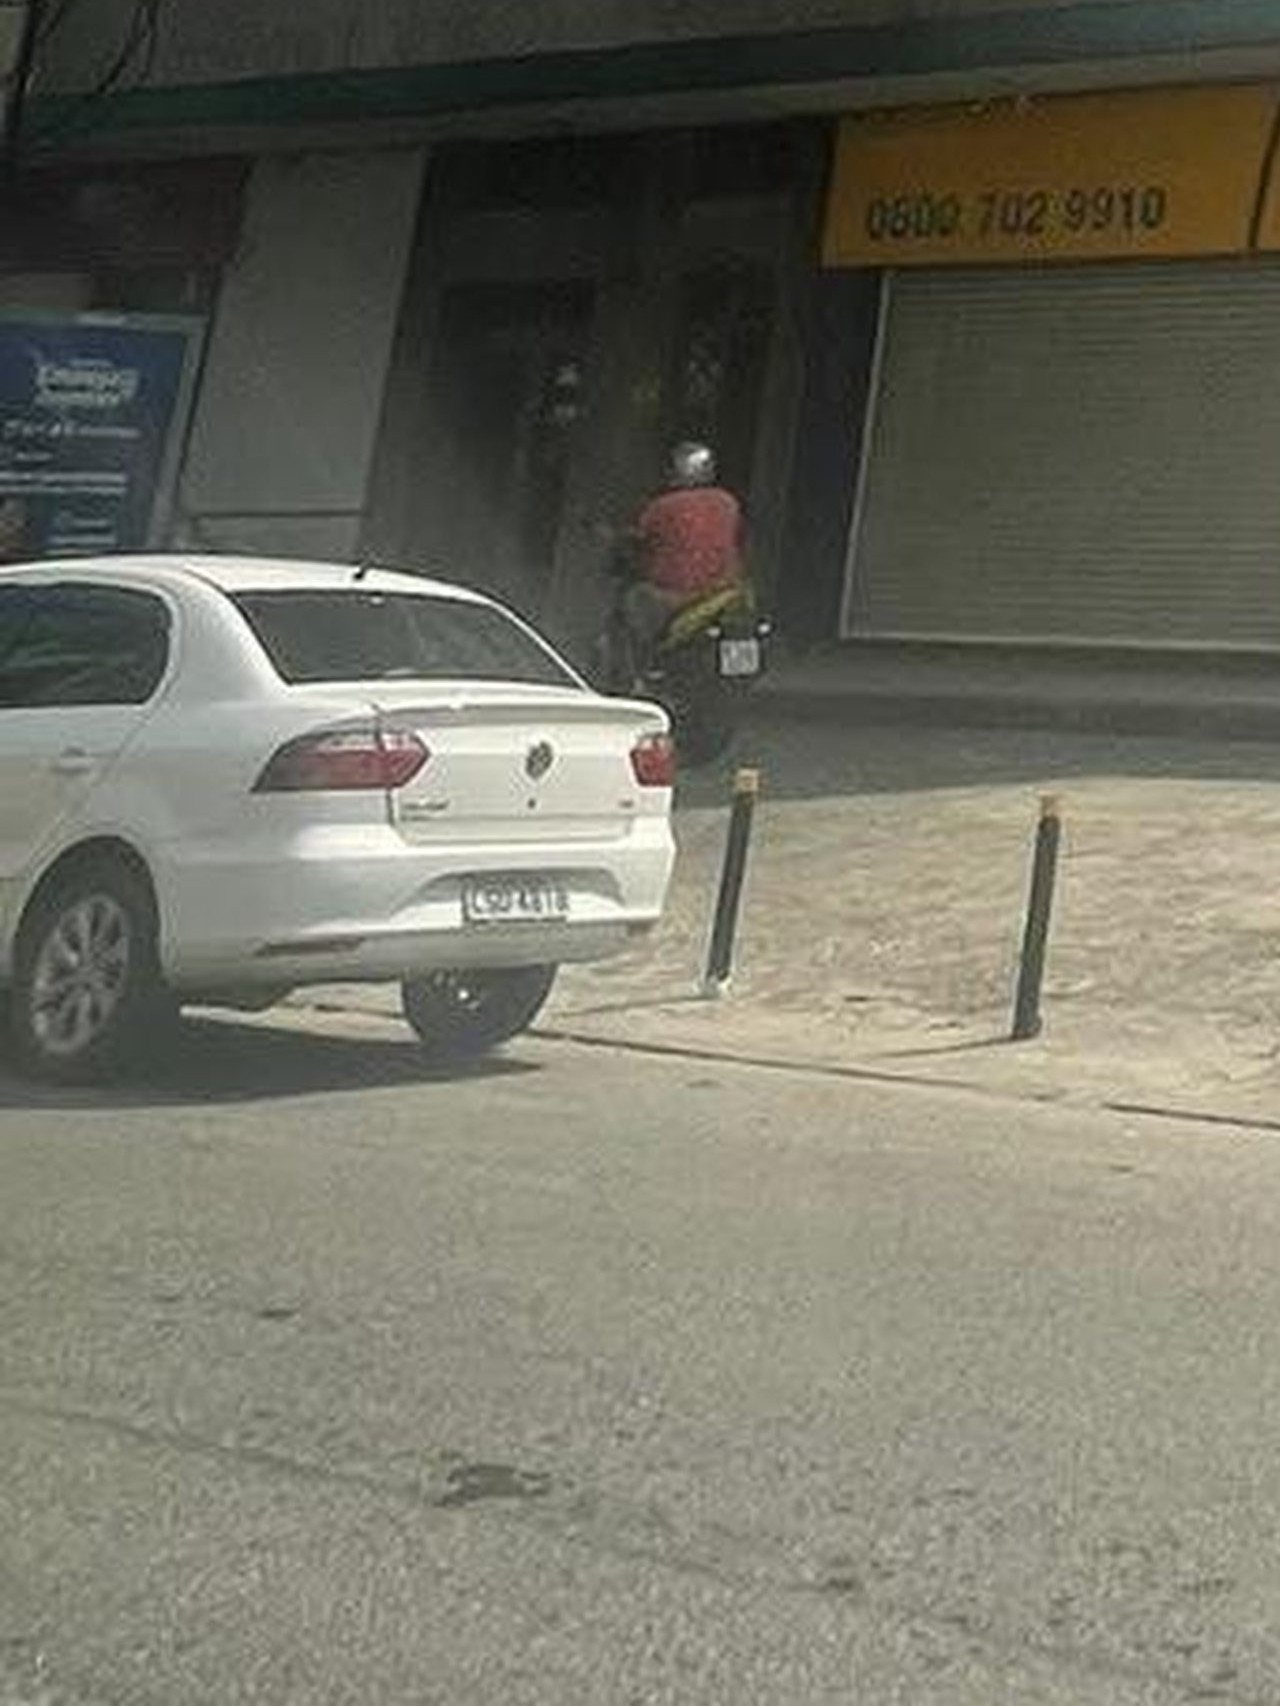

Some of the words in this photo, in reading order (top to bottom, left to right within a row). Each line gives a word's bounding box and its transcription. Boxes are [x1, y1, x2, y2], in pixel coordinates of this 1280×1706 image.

[865, 193, 962, 241] 0800
[978, 189, 1049, 236] 702
[1064, 186, 1167, 233] 9910
